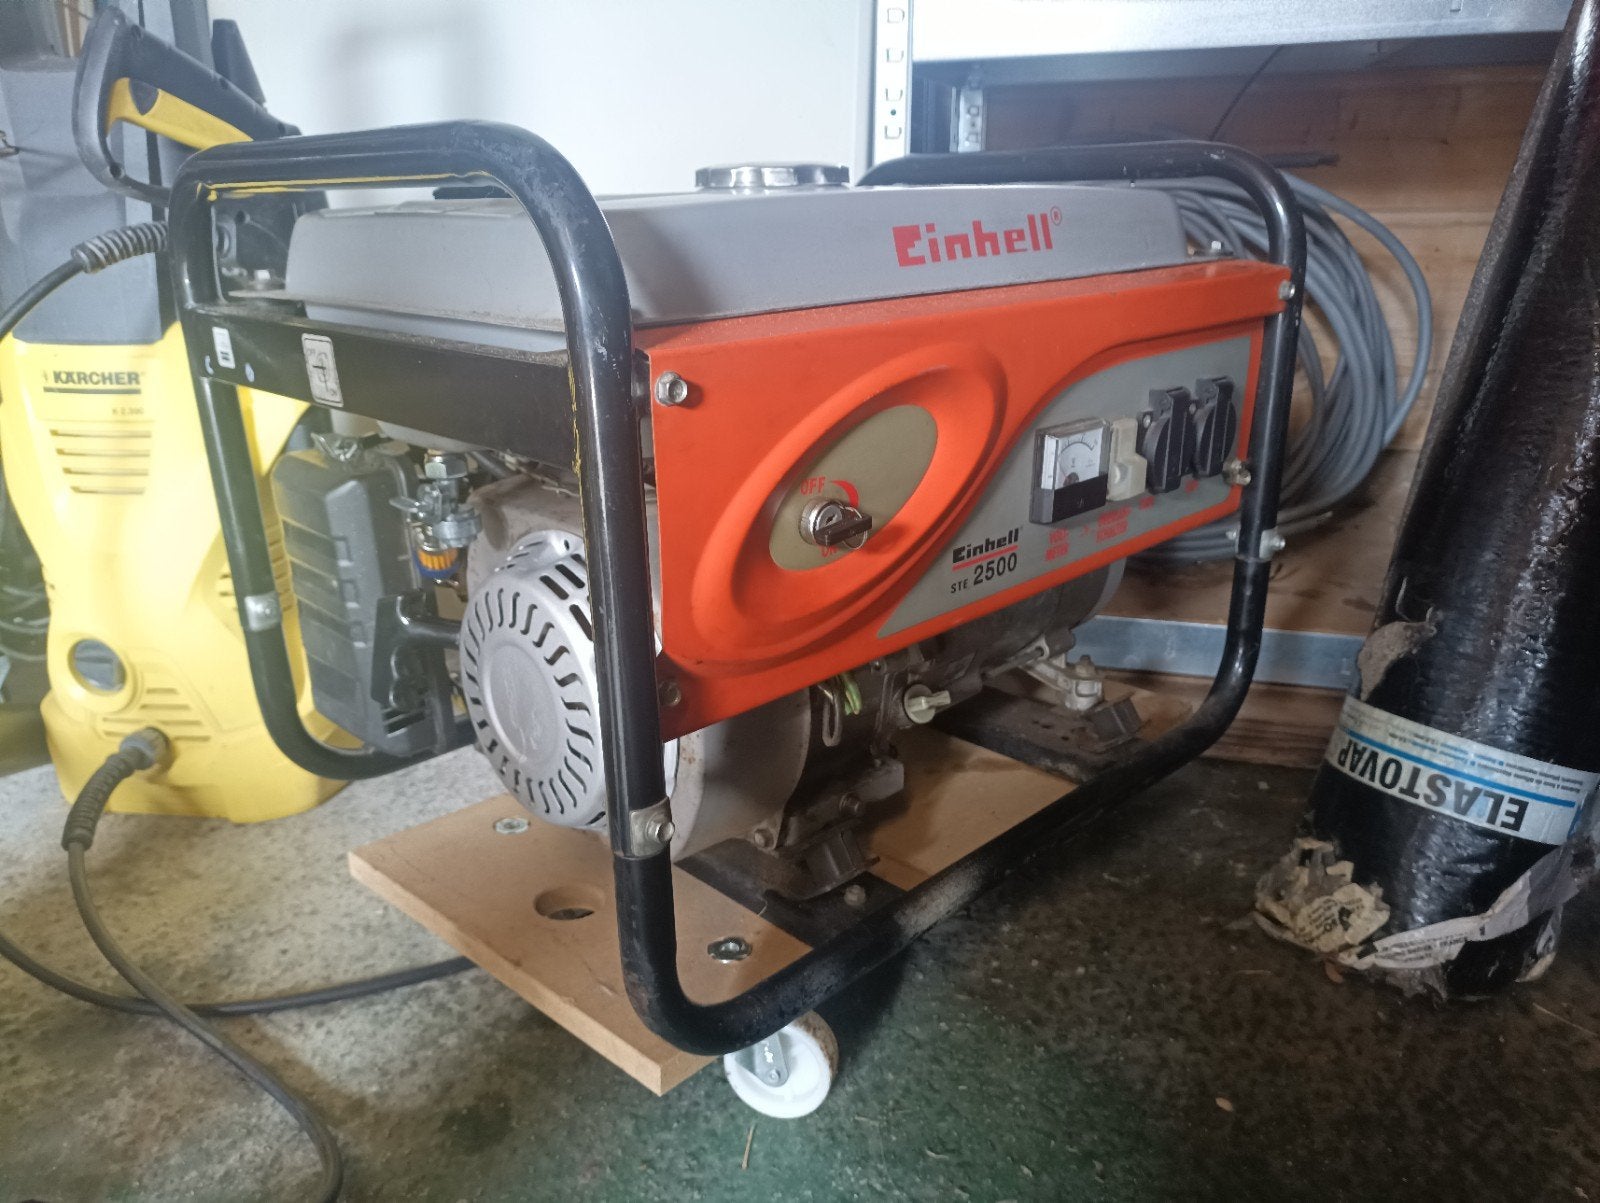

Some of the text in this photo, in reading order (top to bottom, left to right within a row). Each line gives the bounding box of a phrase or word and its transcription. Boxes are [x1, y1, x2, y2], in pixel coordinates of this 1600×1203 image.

[801, 476, 826, 496] OFF
[952, 527, 1019, 564] Einhell
[950, 552, 1018, 594] STE 2500
[1338, 740, 1530, 832] ELASTOVAP
